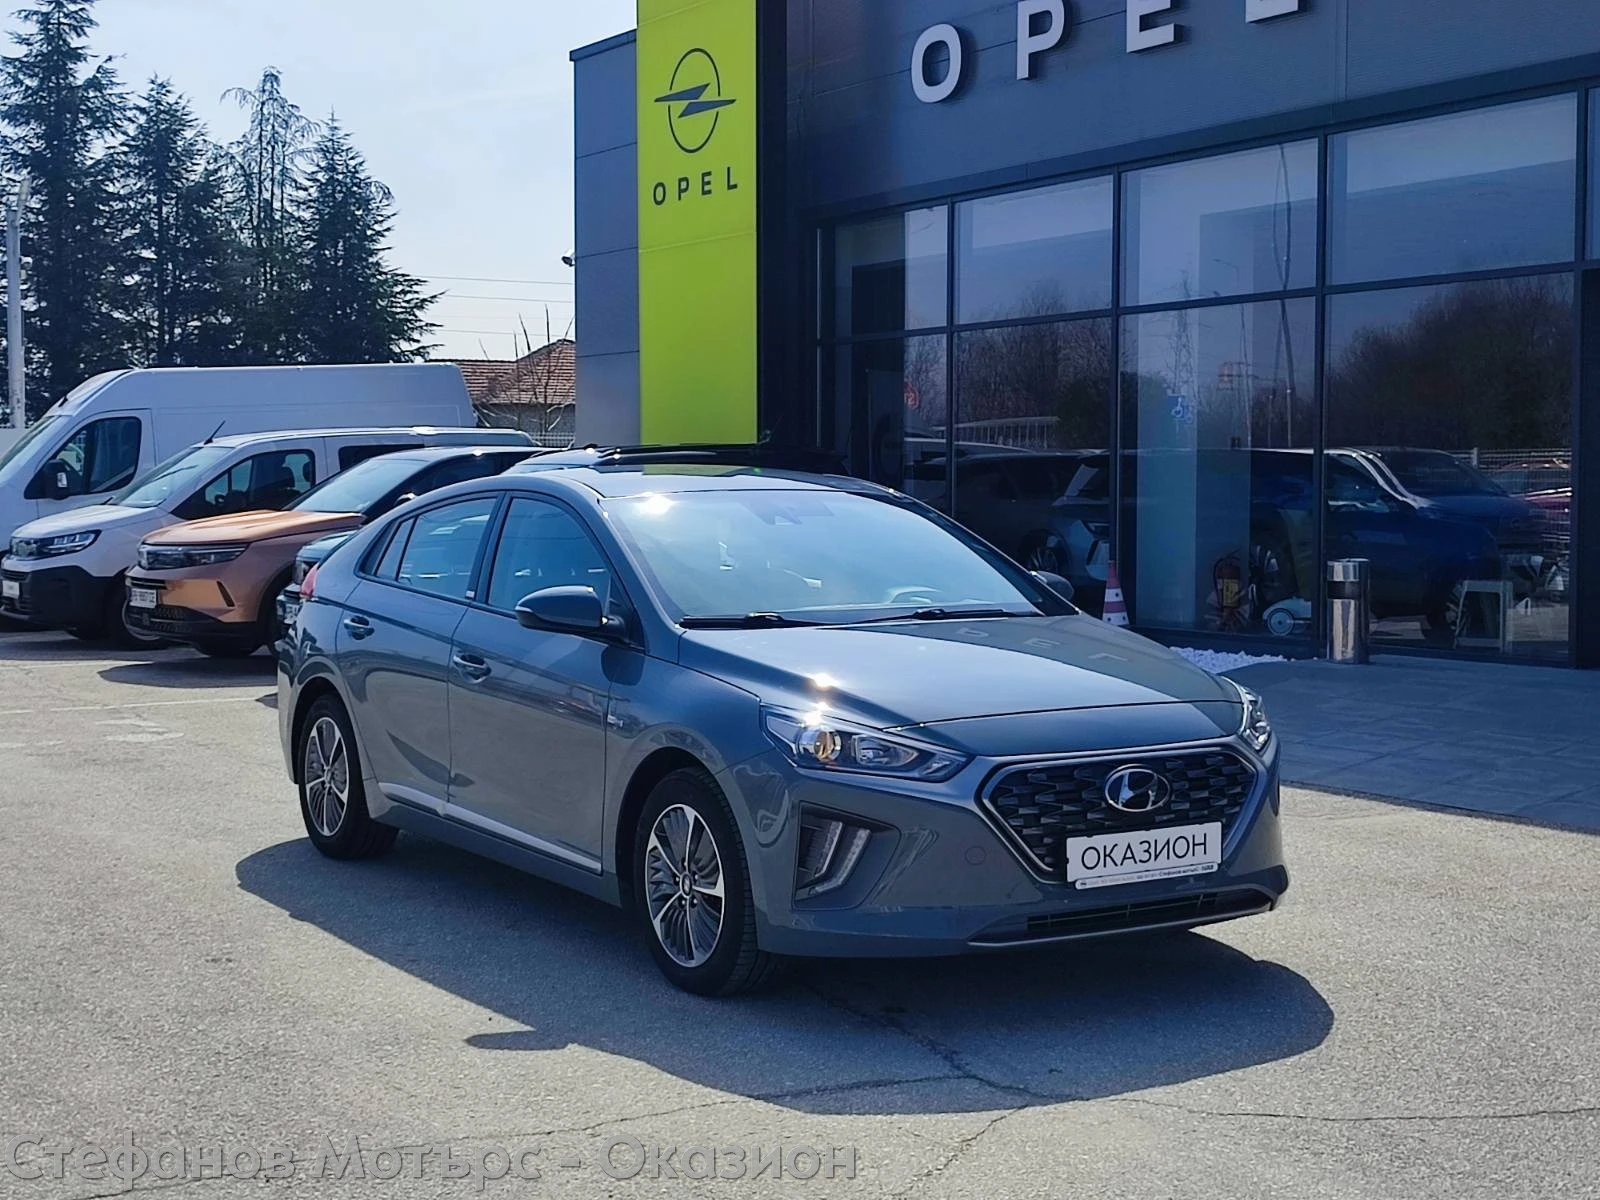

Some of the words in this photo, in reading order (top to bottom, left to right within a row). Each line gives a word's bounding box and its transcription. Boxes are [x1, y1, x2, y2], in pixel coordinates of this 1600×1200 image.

[911, 0, 1299, 102] OPE
[653, 167, 738, 205] OPEL
[1081, 832, 1207, 870] ОКАЗИОН
